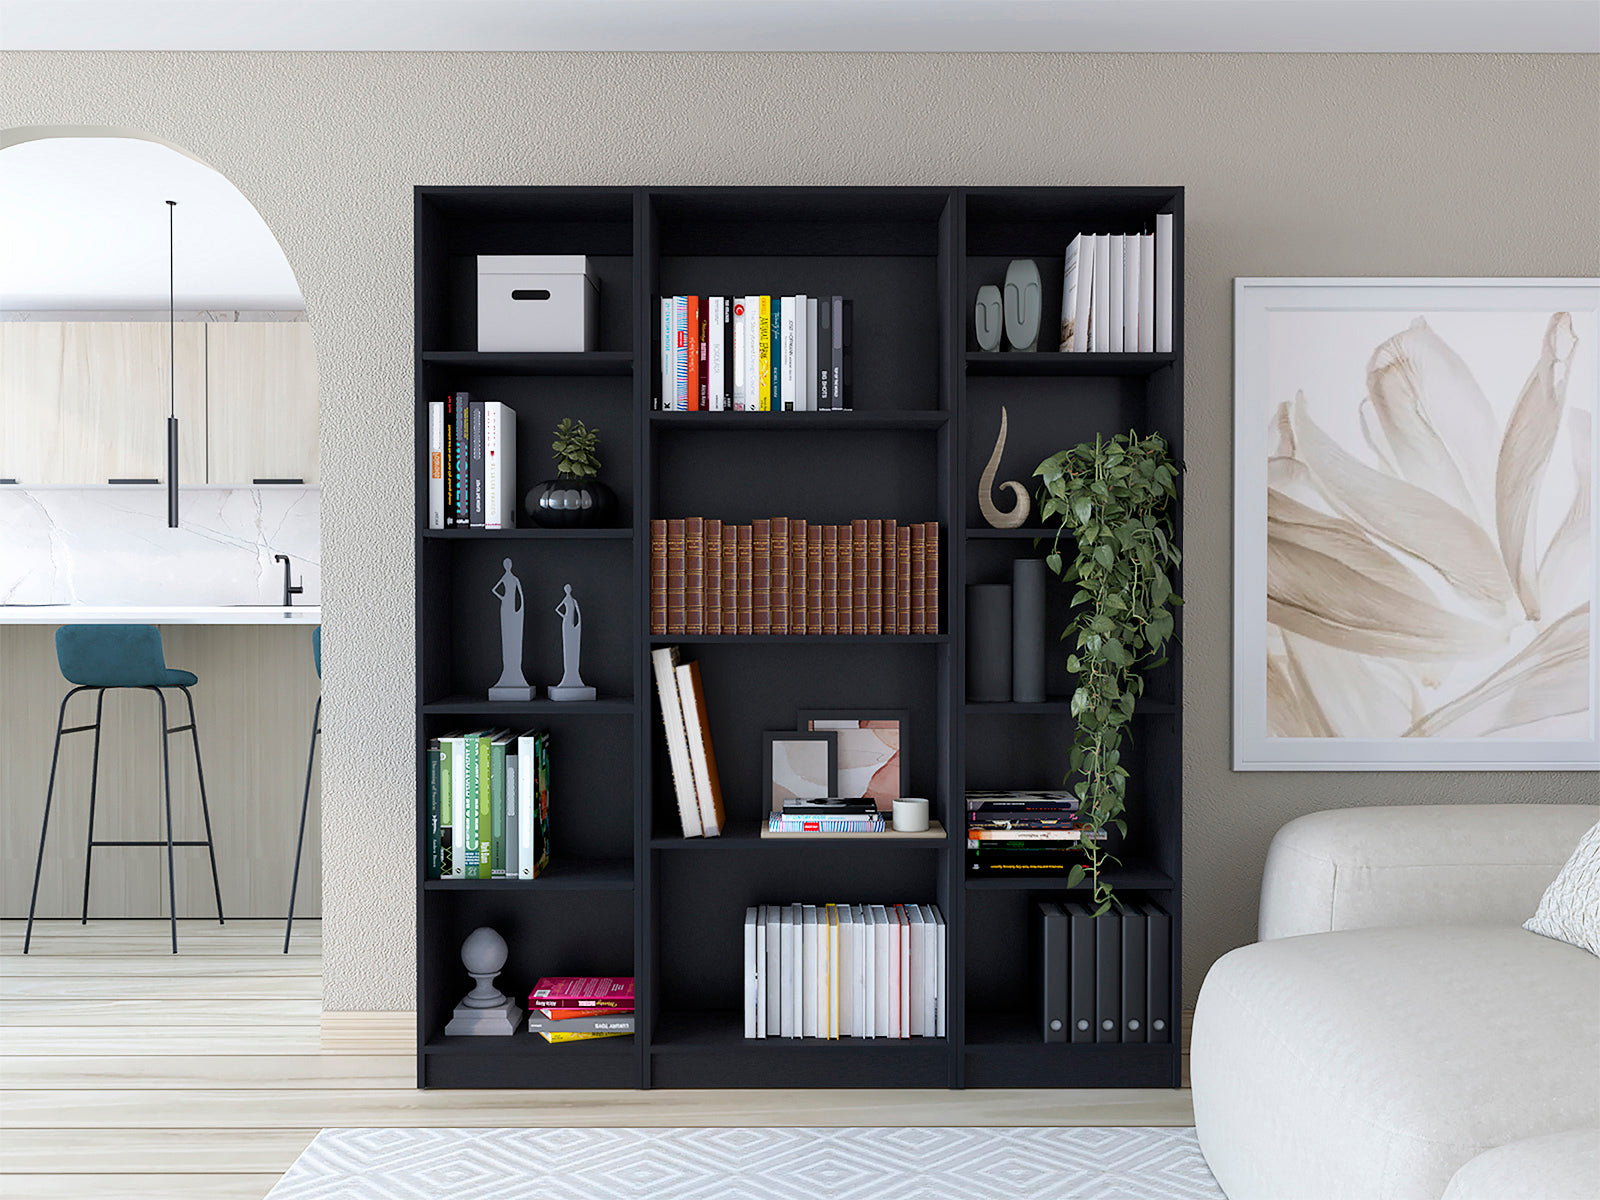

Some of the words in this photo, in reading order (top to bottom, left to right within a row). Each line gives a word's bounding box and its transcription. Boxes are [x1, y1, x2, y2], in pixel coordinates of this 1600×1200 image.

[760, 317, 769, 341] ANIMAL
[480, 841, 490, 853] Mark
[480, 853, 489, 864] Dunn
